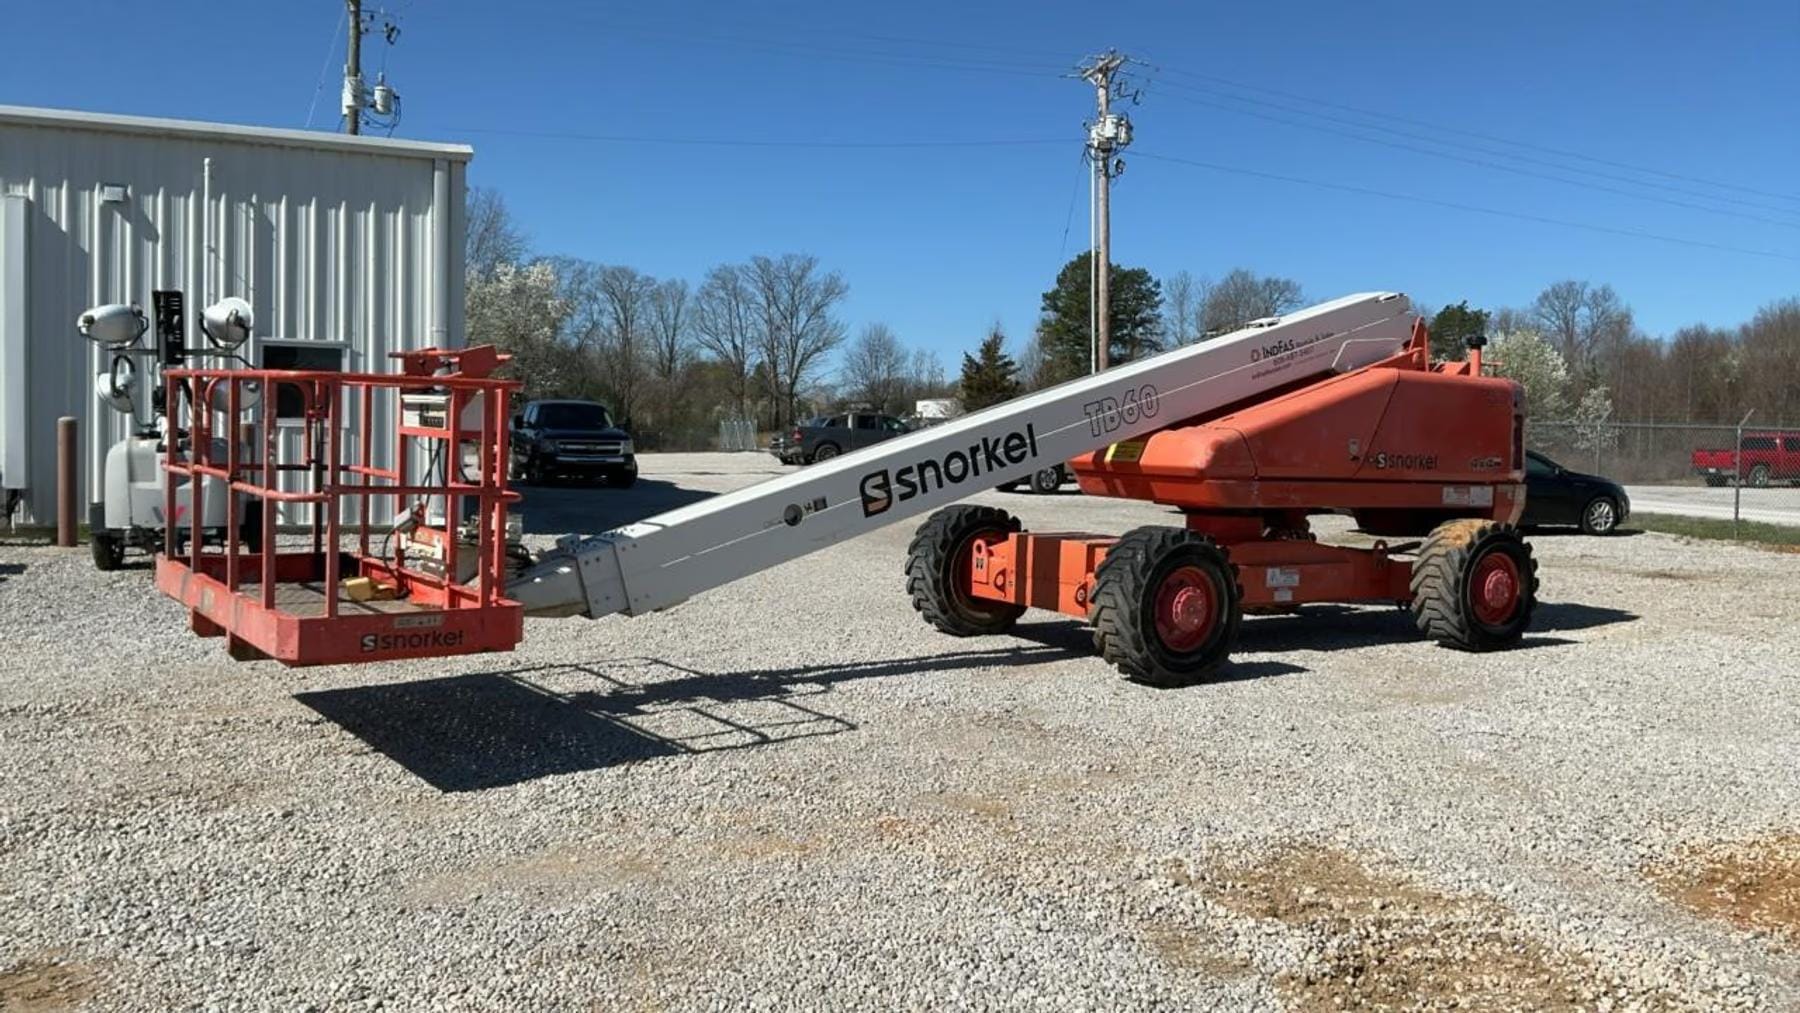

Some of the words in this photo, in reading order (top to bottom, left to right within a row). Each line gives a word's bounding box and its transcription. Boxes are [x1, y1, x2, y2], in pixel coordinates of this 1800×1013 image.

[1083, 384, 1160, 438] TB60
[898, 423, 1038, 502] snorkel
[1388, 454, 1438, 470] snorkel
[381, 629, 464, 650] snorkel
